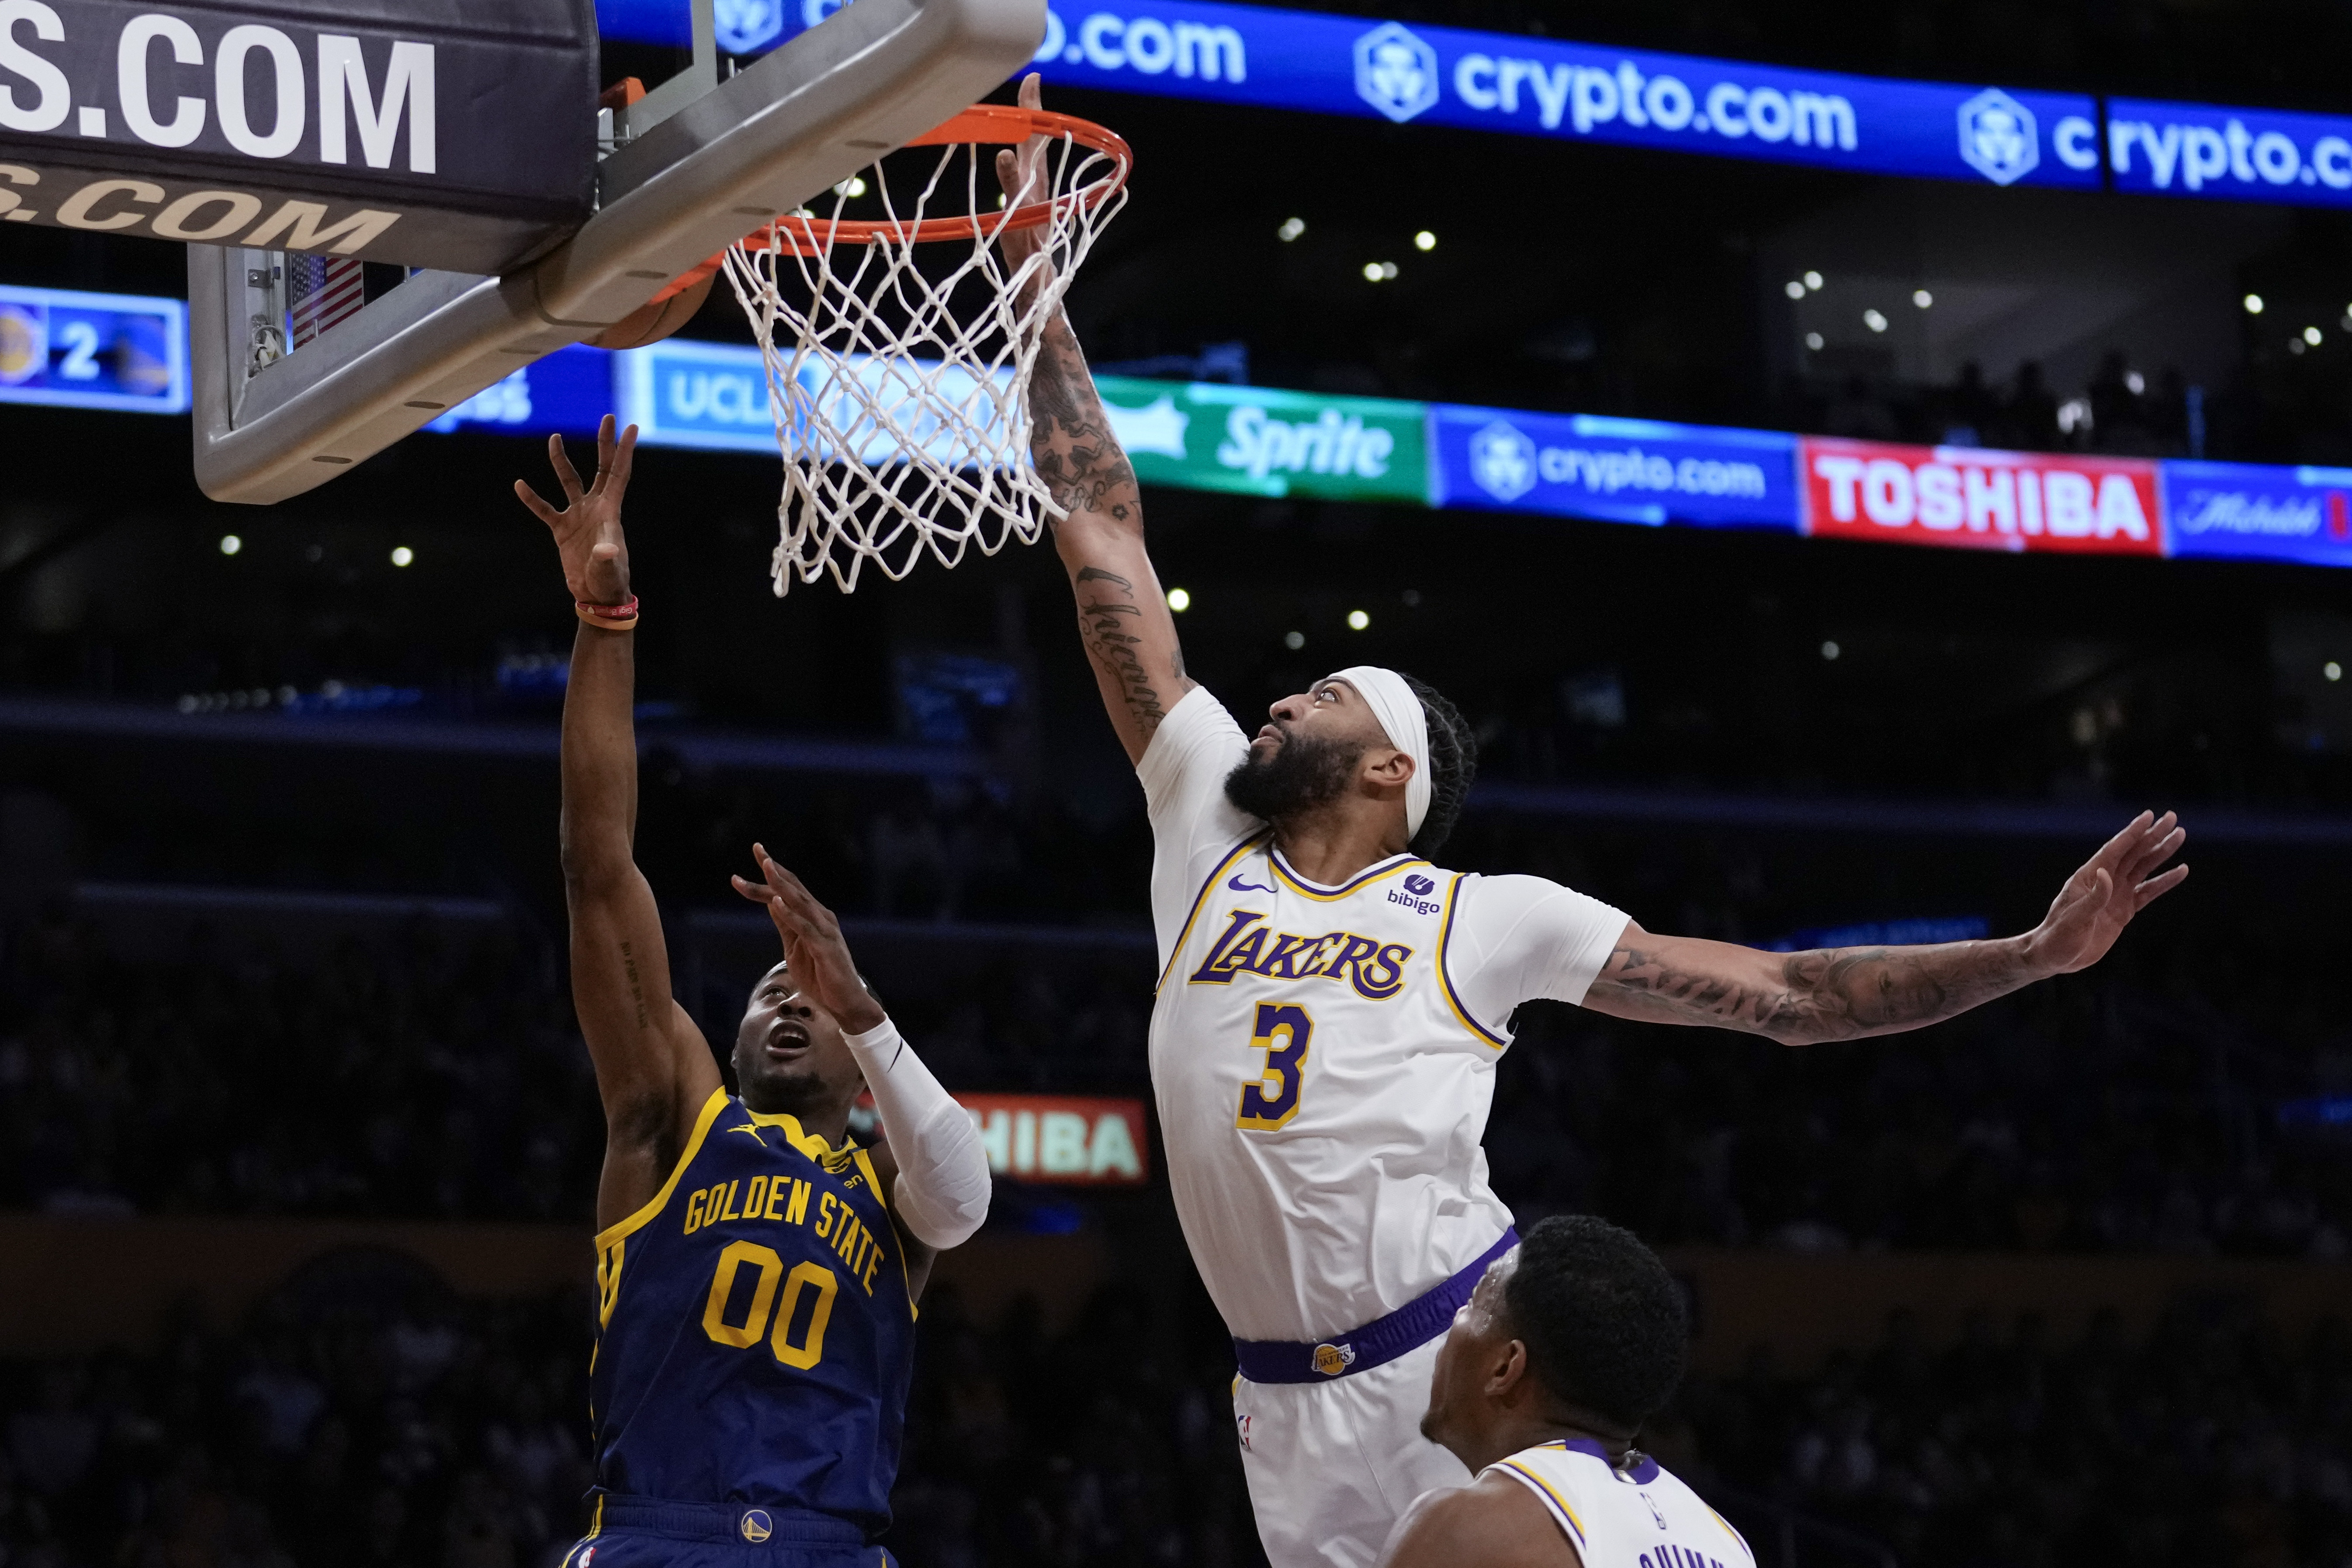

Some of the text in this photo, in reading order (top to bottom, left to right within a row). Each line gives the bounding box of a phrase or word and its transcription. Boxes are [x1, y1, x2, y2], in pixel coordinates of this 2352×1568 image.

[1454, 53, 1859, 149] crypto.com
[59, 320, 100, 381] 2
[1218, 405, 1394, 478] Sprite
[1537, 445, 1767, 500] crypto.com
[1815, 455, 2150, 541] TOSHIBA
[1388, 889, 1440, 915] bibigo
[1187, 908, 1416, 1001] LAKERS
[1236, 1000, 1314, 1132] 3
[683, 1175, 885, 1298] GOLDEN STATE
[702, 1240, 839, 1371] 00
